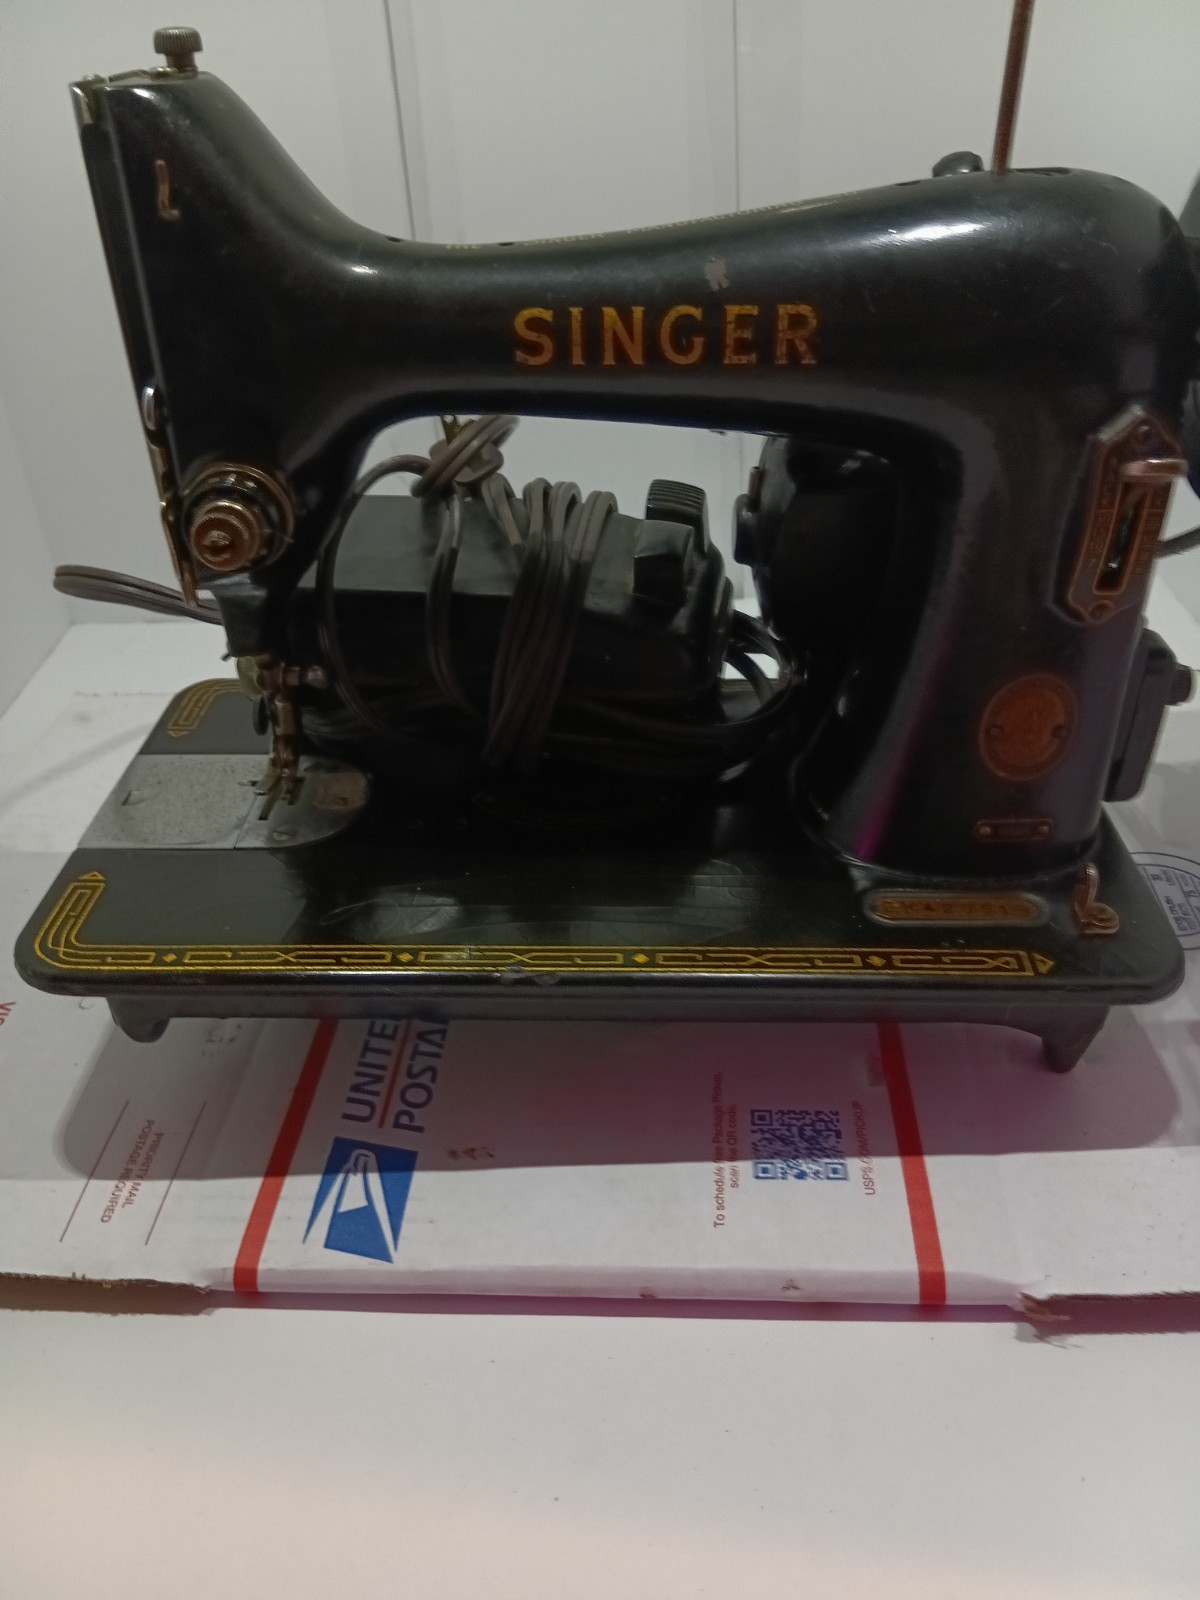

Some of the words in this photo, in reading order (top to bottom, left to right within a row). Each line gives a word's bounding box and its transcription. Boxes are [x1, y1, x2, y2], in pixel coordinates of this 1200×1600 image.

[513, 302, 819, 366] SINGER
[341, 1016, 402, 1123] UNITE
[392, 1015, 451, 1133] POSTA
[127, 1119, 155, 1165] POSTAGE
[712, 1105, 725, 1144] Package
[727, 1130, 738, 1146] QR
[135, 1133, 165, 1179] PRIORITY
[729, 1165, 739, 1189] scan
[101, 1167, 134, 1223] REQUIRED
[122, 1181, 142, 1208] MAIL
[713, 1167, 725, 1211] schedule
[713, 1213, 725, 1228] To
